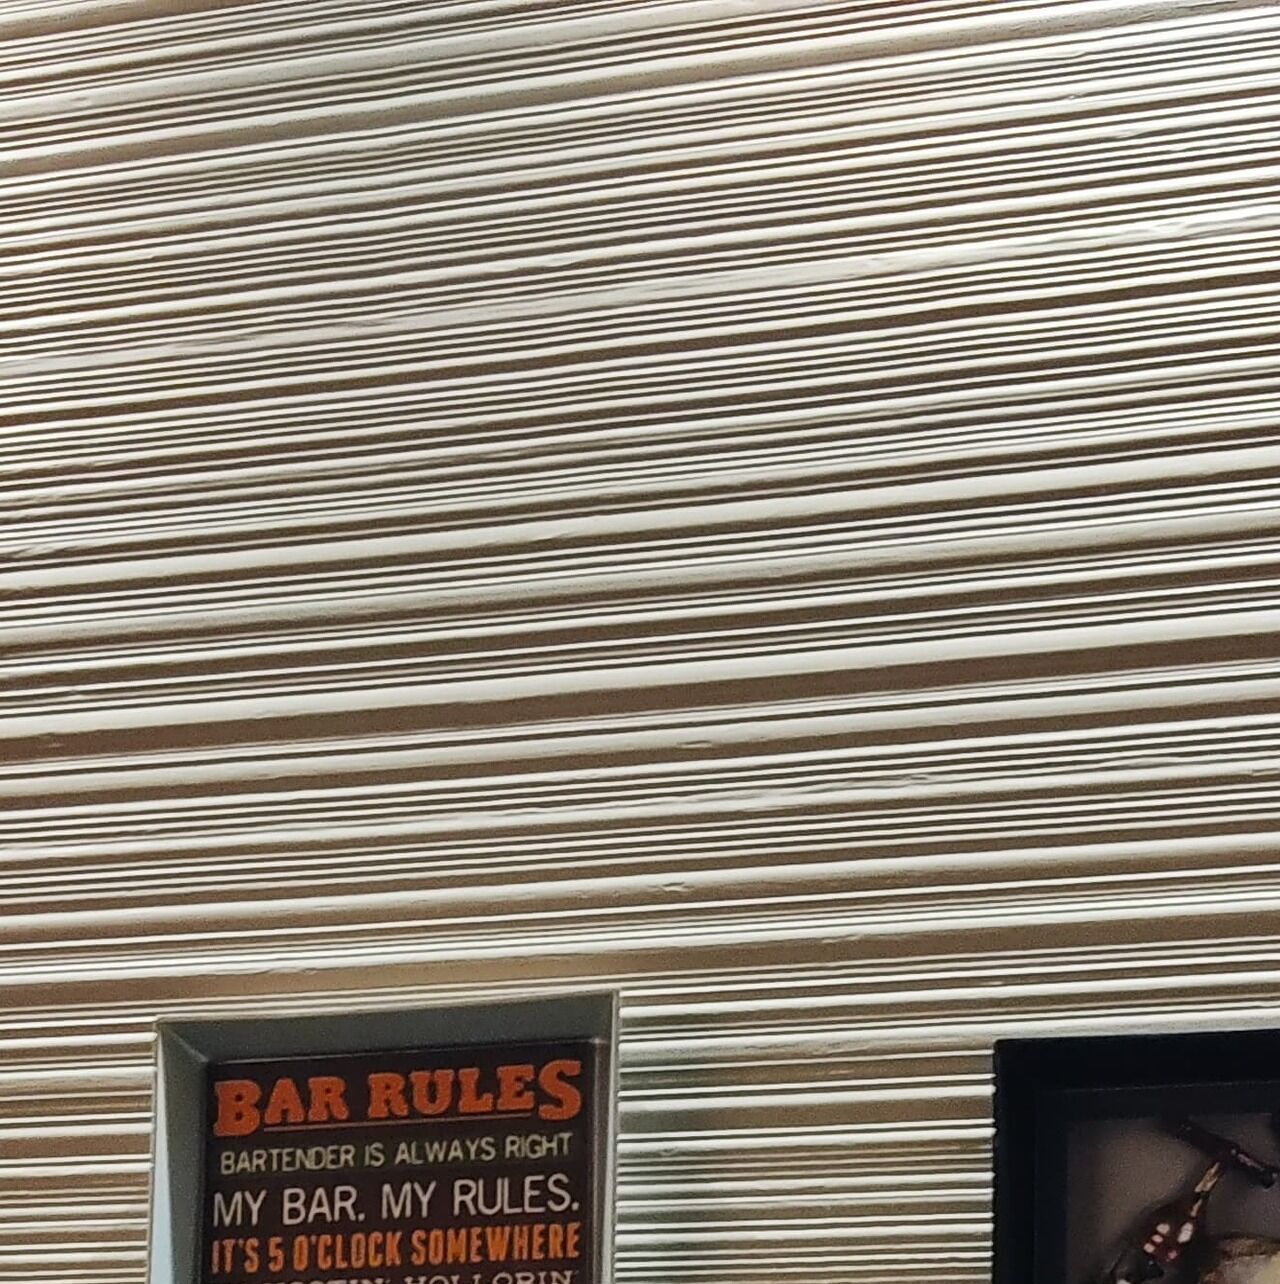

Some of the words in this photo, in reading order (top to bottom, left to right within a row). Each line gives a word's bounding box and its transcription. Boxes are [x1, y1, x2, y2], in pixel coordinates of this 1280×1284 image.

[214, 1076, 349, 1137] BAR
[368, 1059, 582, 1121] RULES
[221, 1143, 355, 1176] BARTENDER
[365, 1142, 385, 1167] IS
[395, 1137, 496, 1165] ALWAYS
[505, 1132, 573, 1159] RIGHT
[213, 1190, 266, 1228] MY
[283, 1185, 366, 1225] BAR.
[381, 1180, 436, 1220] MY
[454, 1173, 580, 1217] RULES.
[210, 1236, 259, 1275] IT'S
[268, 1236, 284, 1272] 5
[293, 1231, 401, 1271] O'CLOCK
[411, 1222, 582, 1265] SOMEWHERE
